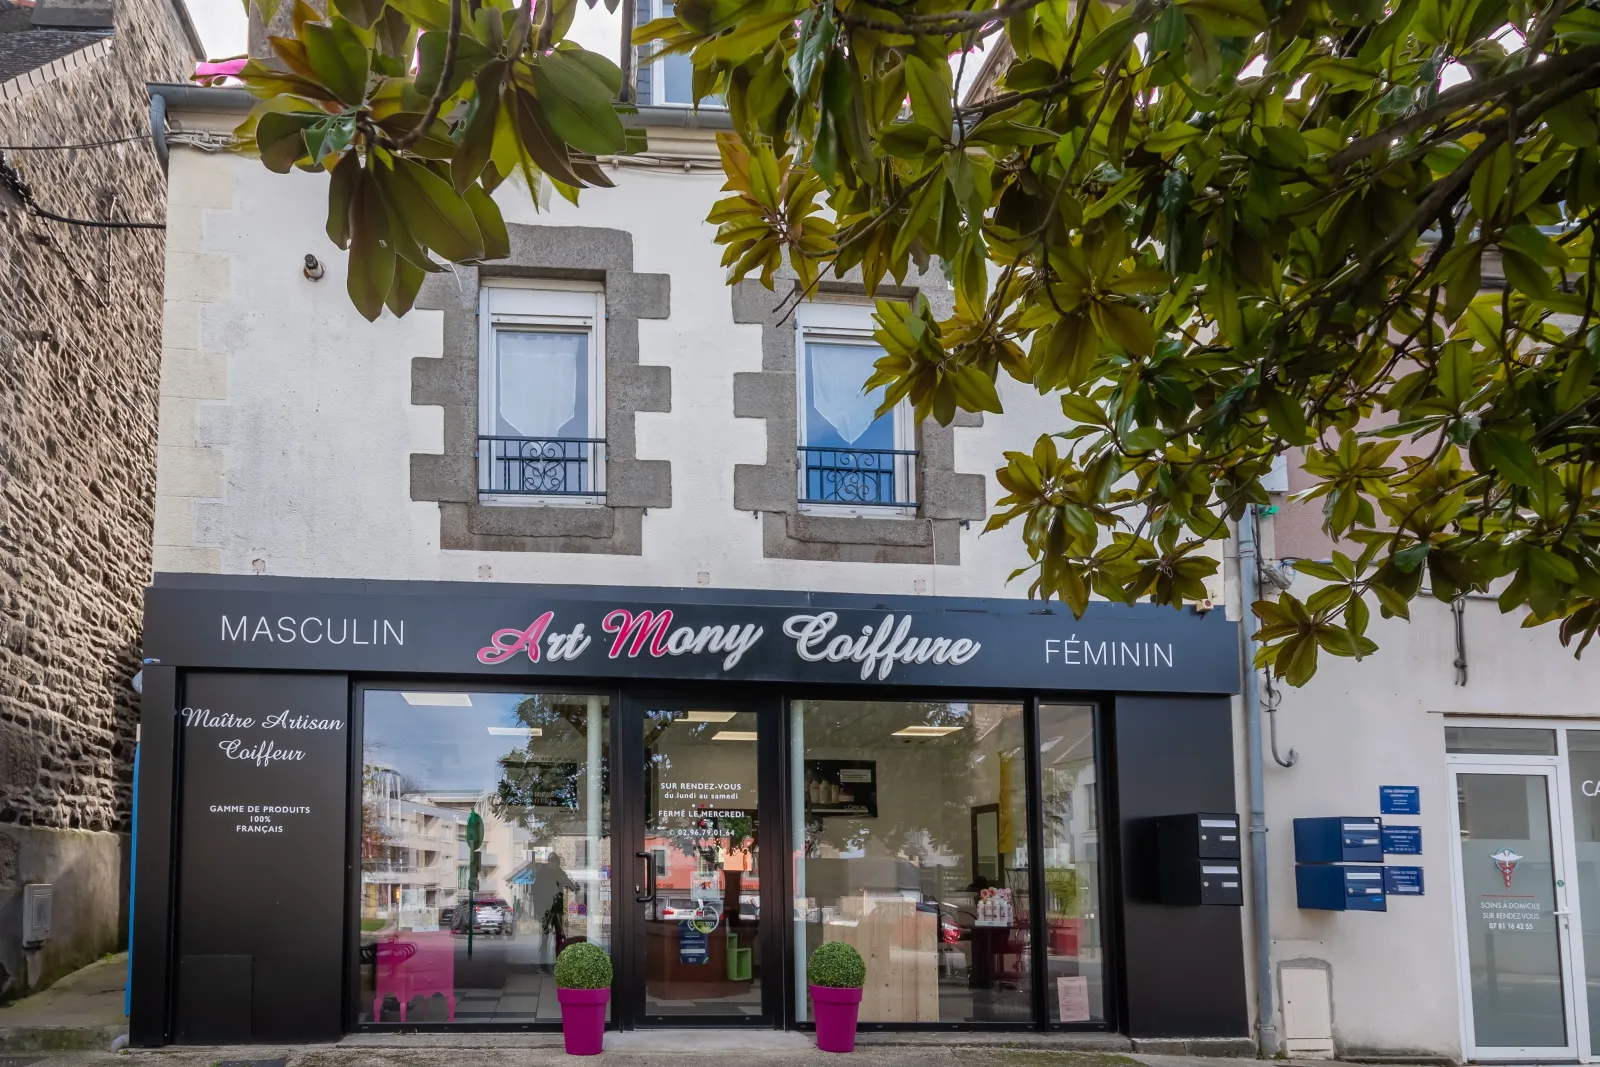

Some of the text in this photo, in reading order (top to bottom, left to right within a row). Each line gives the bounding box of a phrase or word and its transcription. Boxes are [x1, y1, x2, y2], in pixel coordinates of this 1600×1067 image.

[221, 615, 404, 645] MASCULIN
[476, 608, 981, 681] Art Mony Coiffure
[1044, 633, 1174, 668] FÉMININ
[181, 707, 345, 730] Maître Artisan
[218, 738, 306, 767] Coiffeur
[660, 782, 742, 791] SUR RENDEZ-VOUS
[664, 791, 674, 799] du
[676, 791, 697, 799] lundi
[711, 792, 738, 800] samedi
[209, 805, 311, 814] GAMME DE PRODUITS
[658, 809, 745, 818] FERMÉ LE MERCREDI
[249, 815, 271, 823] 100%
[236, 825, 284, 834] FRANÇAIS
[1480, 901, 1502, 909] SOINS
[1508, 902, 1541, 910] DOMICILE
